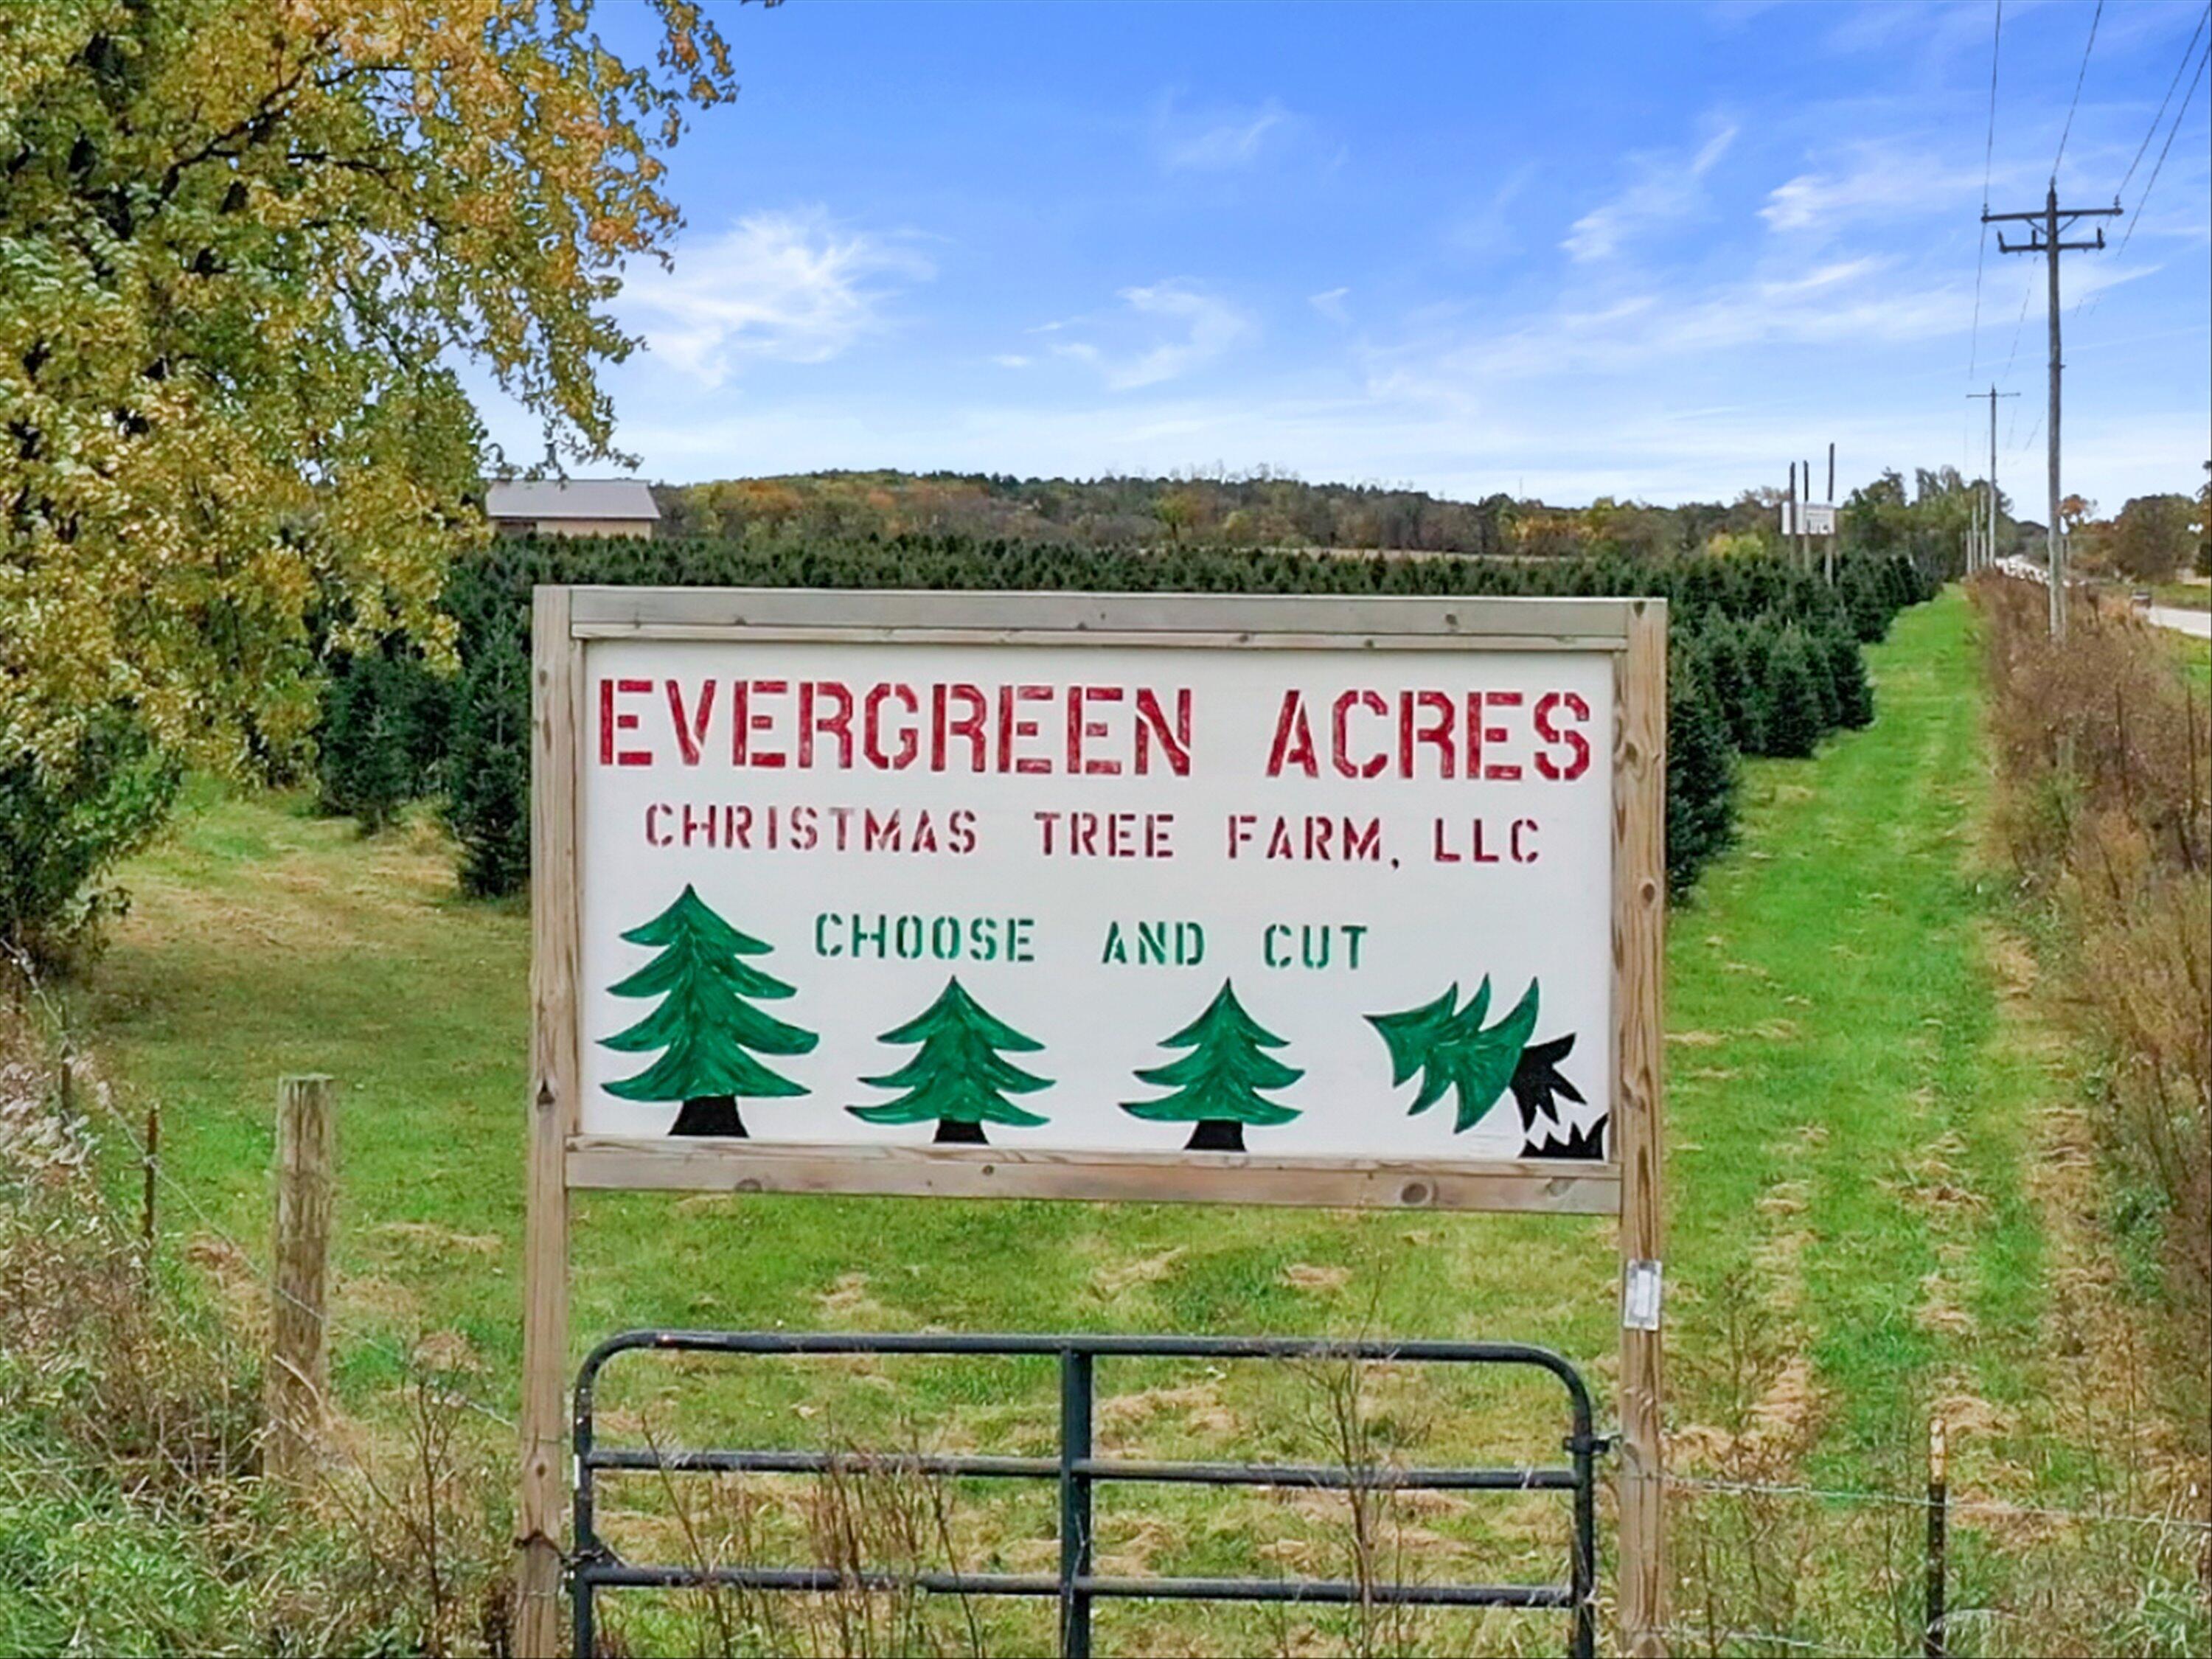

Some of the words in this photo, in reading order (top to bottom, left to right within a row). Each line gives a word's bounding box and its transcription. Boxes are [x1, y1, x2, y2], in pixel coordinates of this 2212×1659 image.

[599, 679, 1192, 776] EVERGREEN
[1266, 689, 1590, 781] ACRES
[645, 804, 977, 854] CHRISTMAS
[1034, 812, 1174, 858] TREE
[1228, 815, 1399, 869] FARM,
[1434, 818, 1540, 863] LLC
[815, 913, 1034, 961] CHOOSE
[1102, 921, 1206, 966] AND
[1263, 924, 1368, 969] CUT
